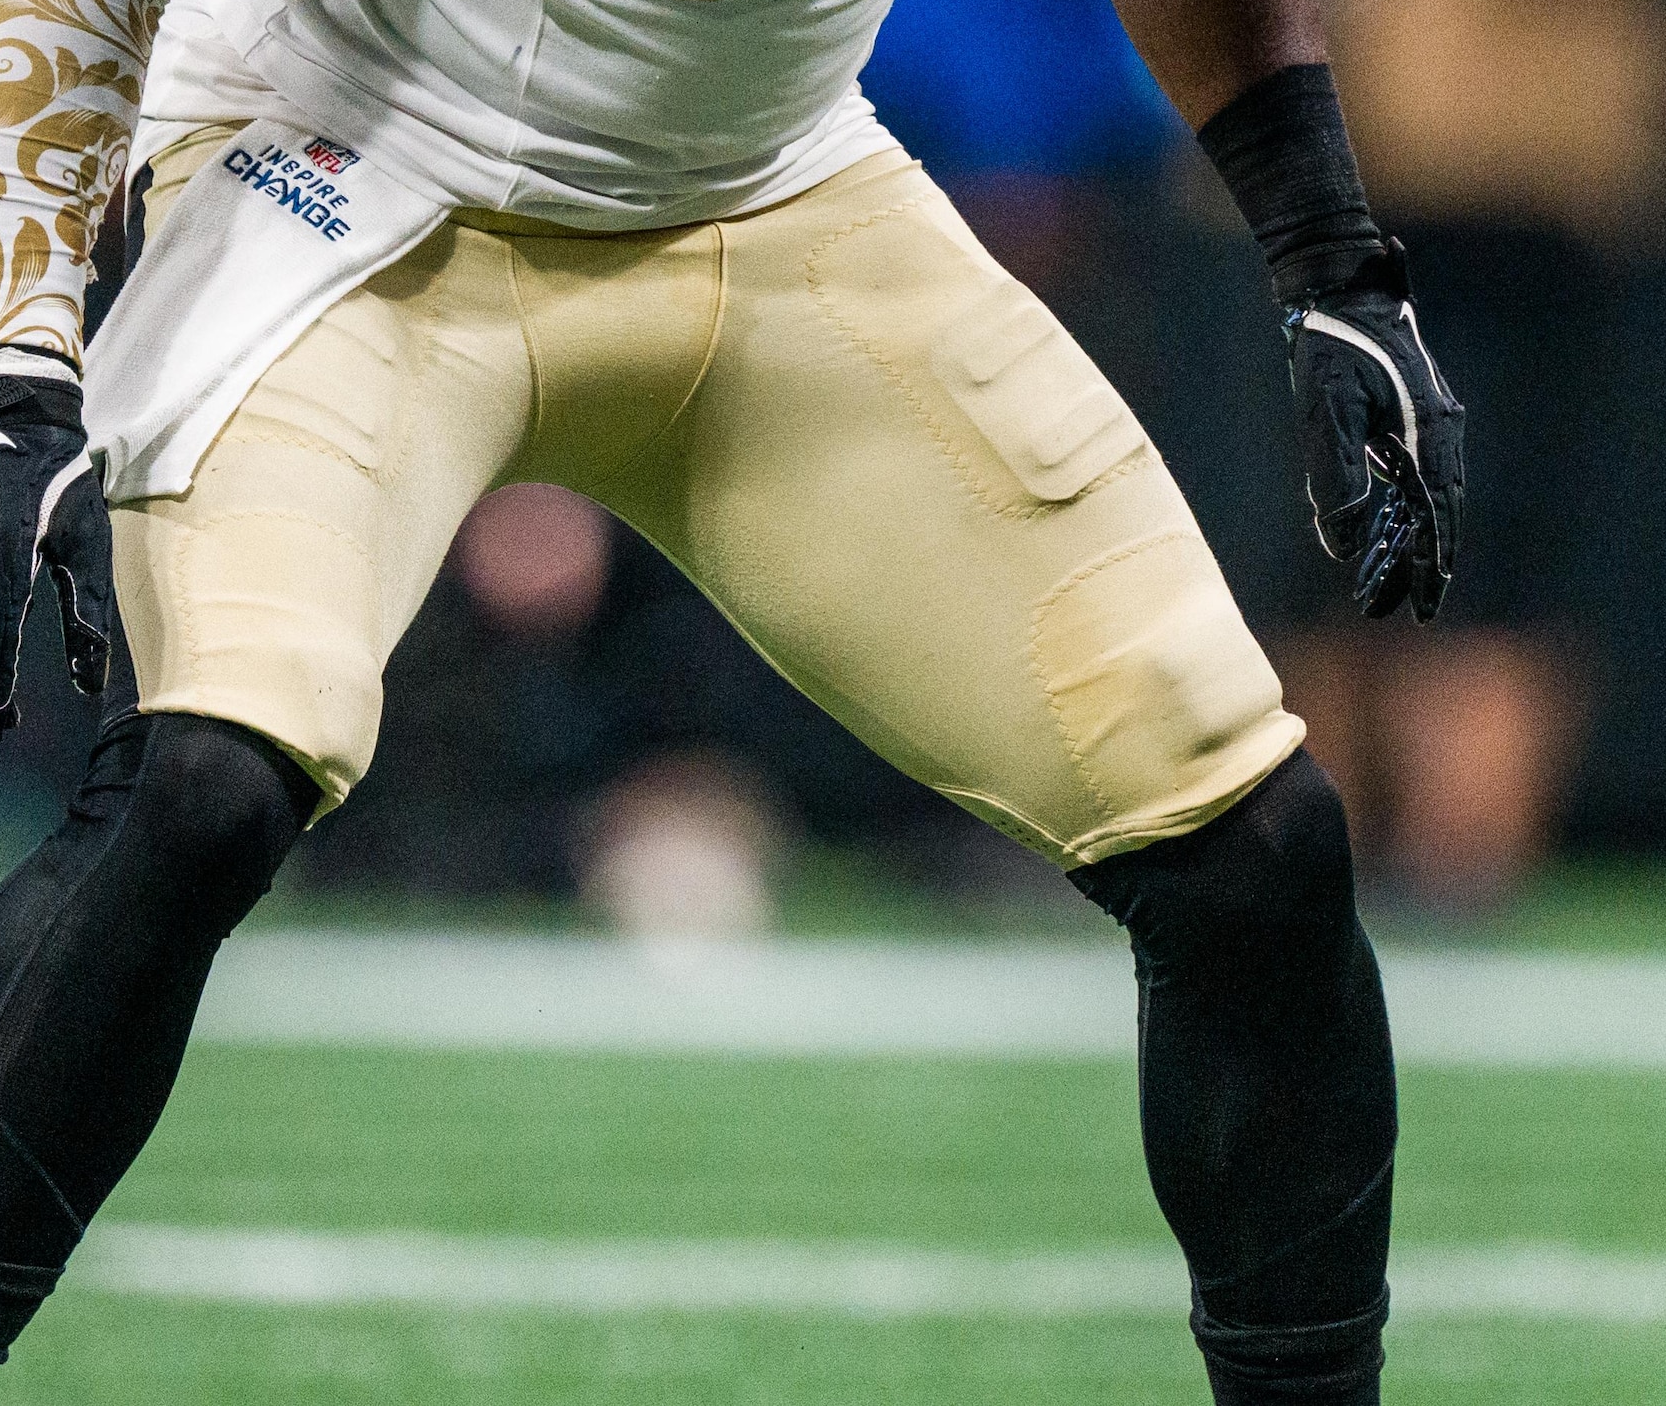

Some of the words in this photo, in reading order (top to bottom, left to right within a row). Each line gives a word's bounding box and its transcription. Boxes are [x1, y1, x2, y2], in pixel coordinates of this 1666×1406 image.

[258, 144, 350, 210] INSPIRE
[306, 144, 342, 176] NFL
[223, 148, 352, 242] CHANGE
